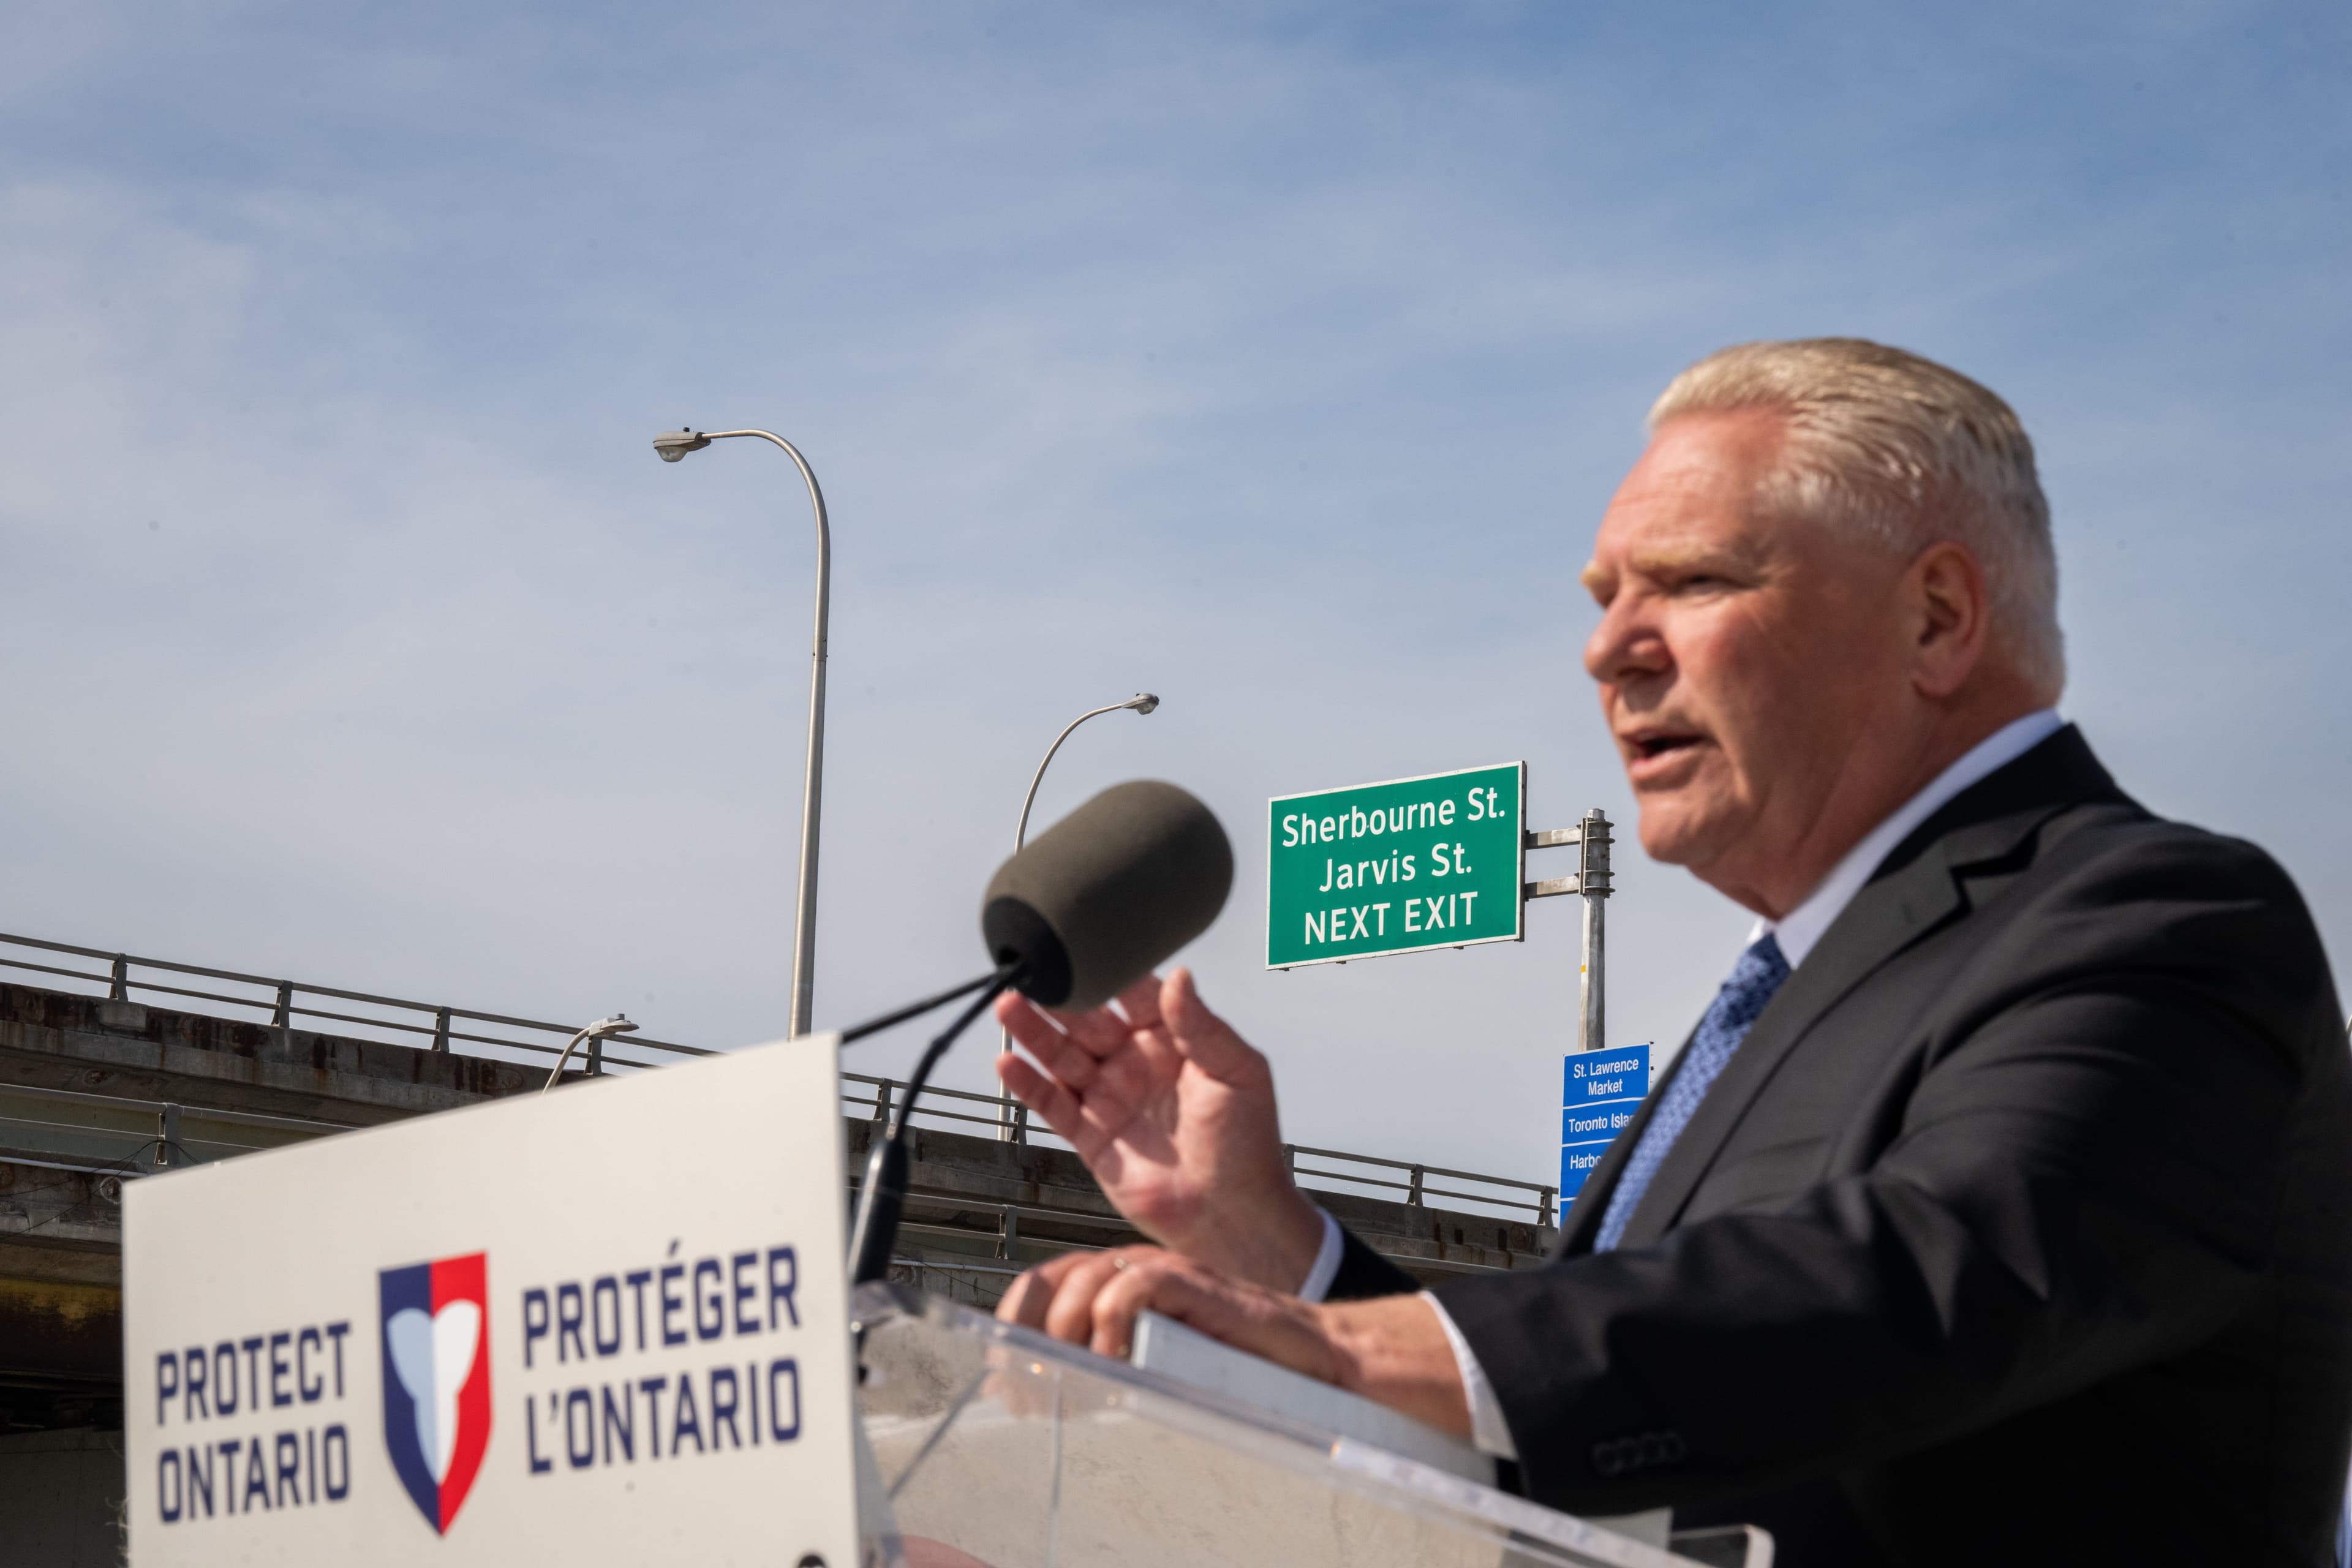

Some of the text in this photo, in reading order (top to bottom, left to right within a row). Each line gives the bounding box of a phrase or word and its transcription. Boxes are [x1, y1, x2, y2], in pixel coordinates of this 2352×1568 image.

[1282, 787, 1506, 847] Sherbourne St.
[1319, 842, 1472, 892] Jarvis St.
[1305, 891, 1478, 945] NEXT EXIT
[1574, 1058, 1639, 1079] St. Lawrence
[1588, 1078, 1623, 1096] Market
[1569, 1116, 1608, 1133] Toronto
[523, 1239, 801, 1368] PROTÉGER
[156, 1321, 351, 1426] PROTECT
[527, 1358, 802, 1475] L'ONTARIO
[157, 1423, 351, 1525] ONTARIO
